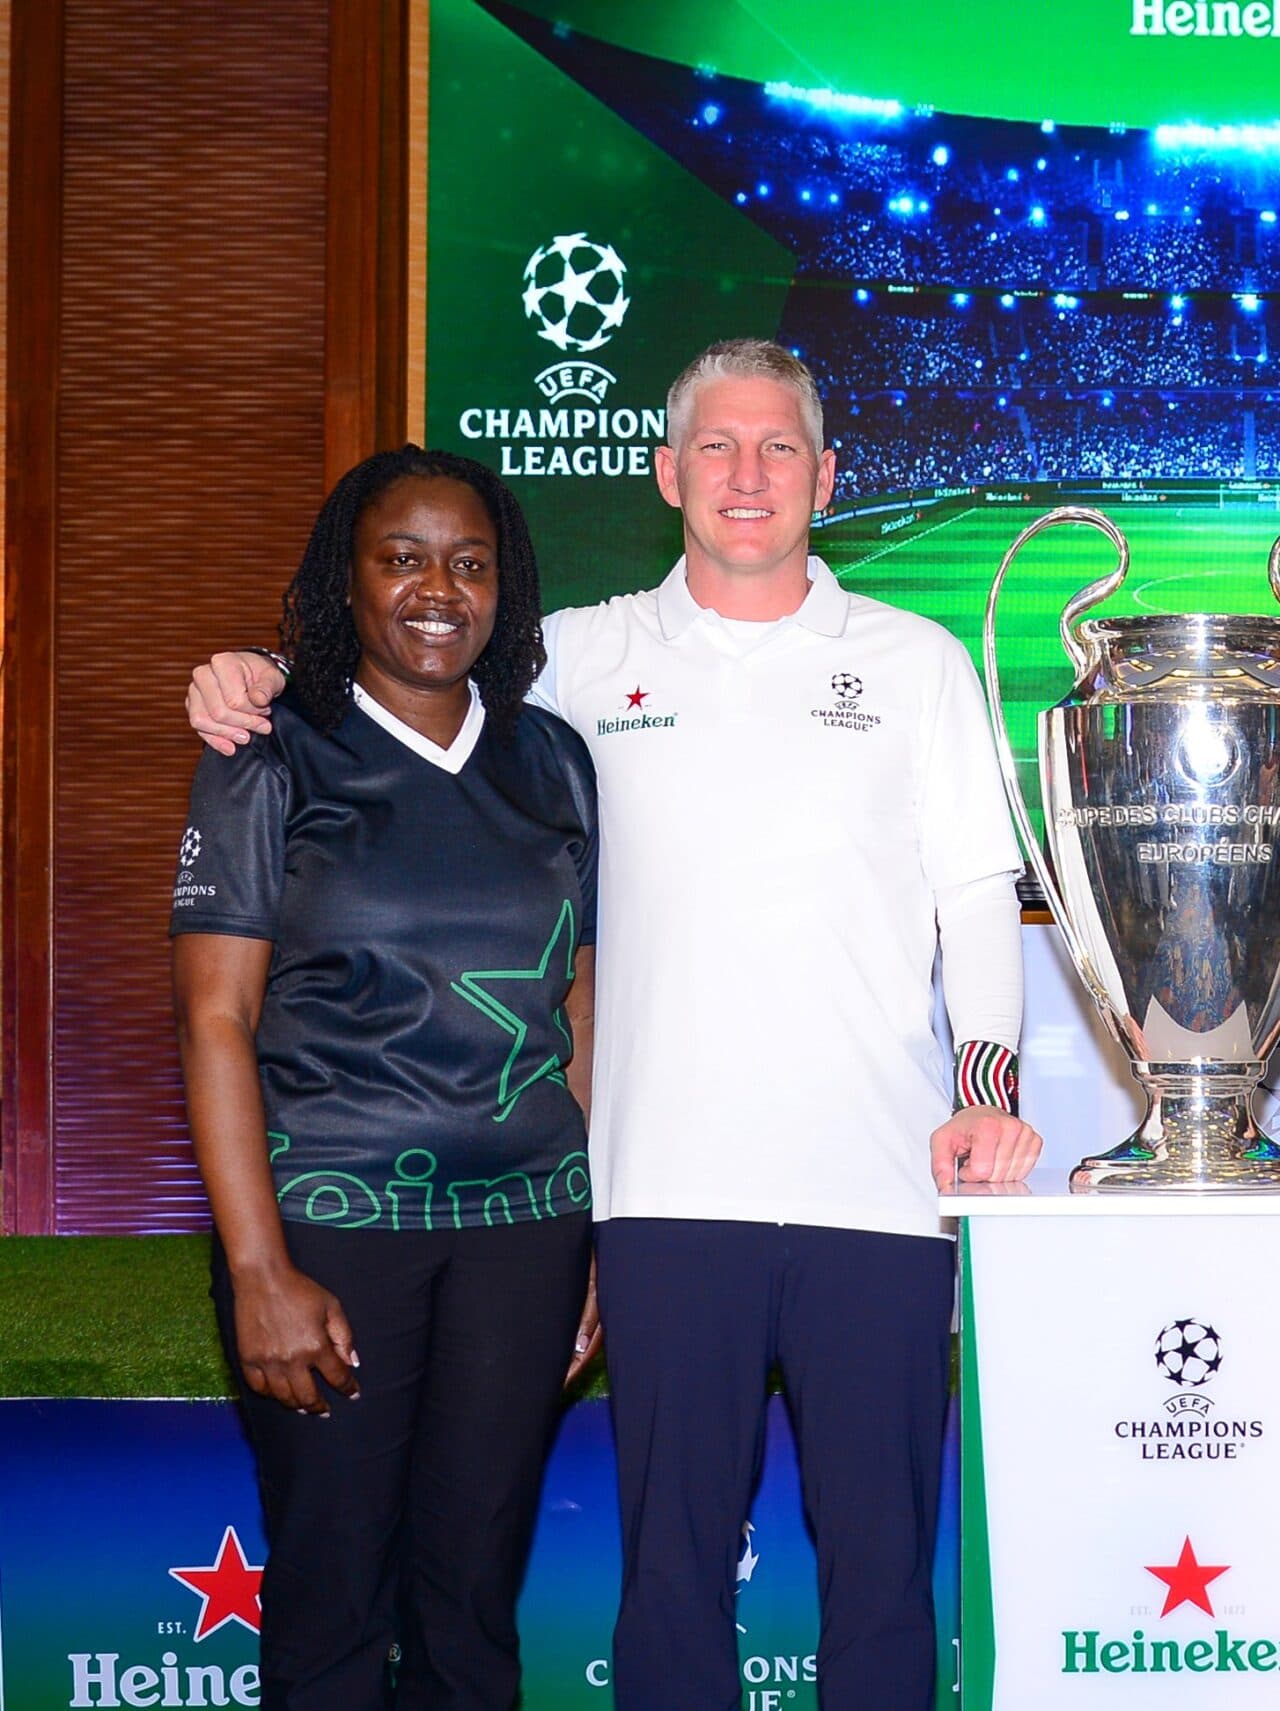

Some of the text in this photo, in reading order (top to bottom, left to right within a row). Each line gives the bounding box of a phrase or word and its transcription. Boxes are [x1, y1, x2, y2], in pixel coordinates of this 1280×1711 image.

[538, 367, 610, 399] UEFA
[459, 408, 666, 439] CHAMPION
[501, 446, 650, 476] LEAGUE
[597, 714, 676, 736] Heineken
[811, 709, 881, 725] CHAMPIONS
[823, 718, 869, 732] LEAGUE
[1113, 805, 1159, 827] DES
[1163, 803, 1240, 826] CLUBS
[1166, 1397, 1210, 1414] UEFA
[1114, 1421, 1264, 1438] CHAMPIONS
[1141, 1443, 1238, 1459] LEAGUE
[157, 1621, 187, 1635] EST.
[68, 1651, 261, 1707] Heine
